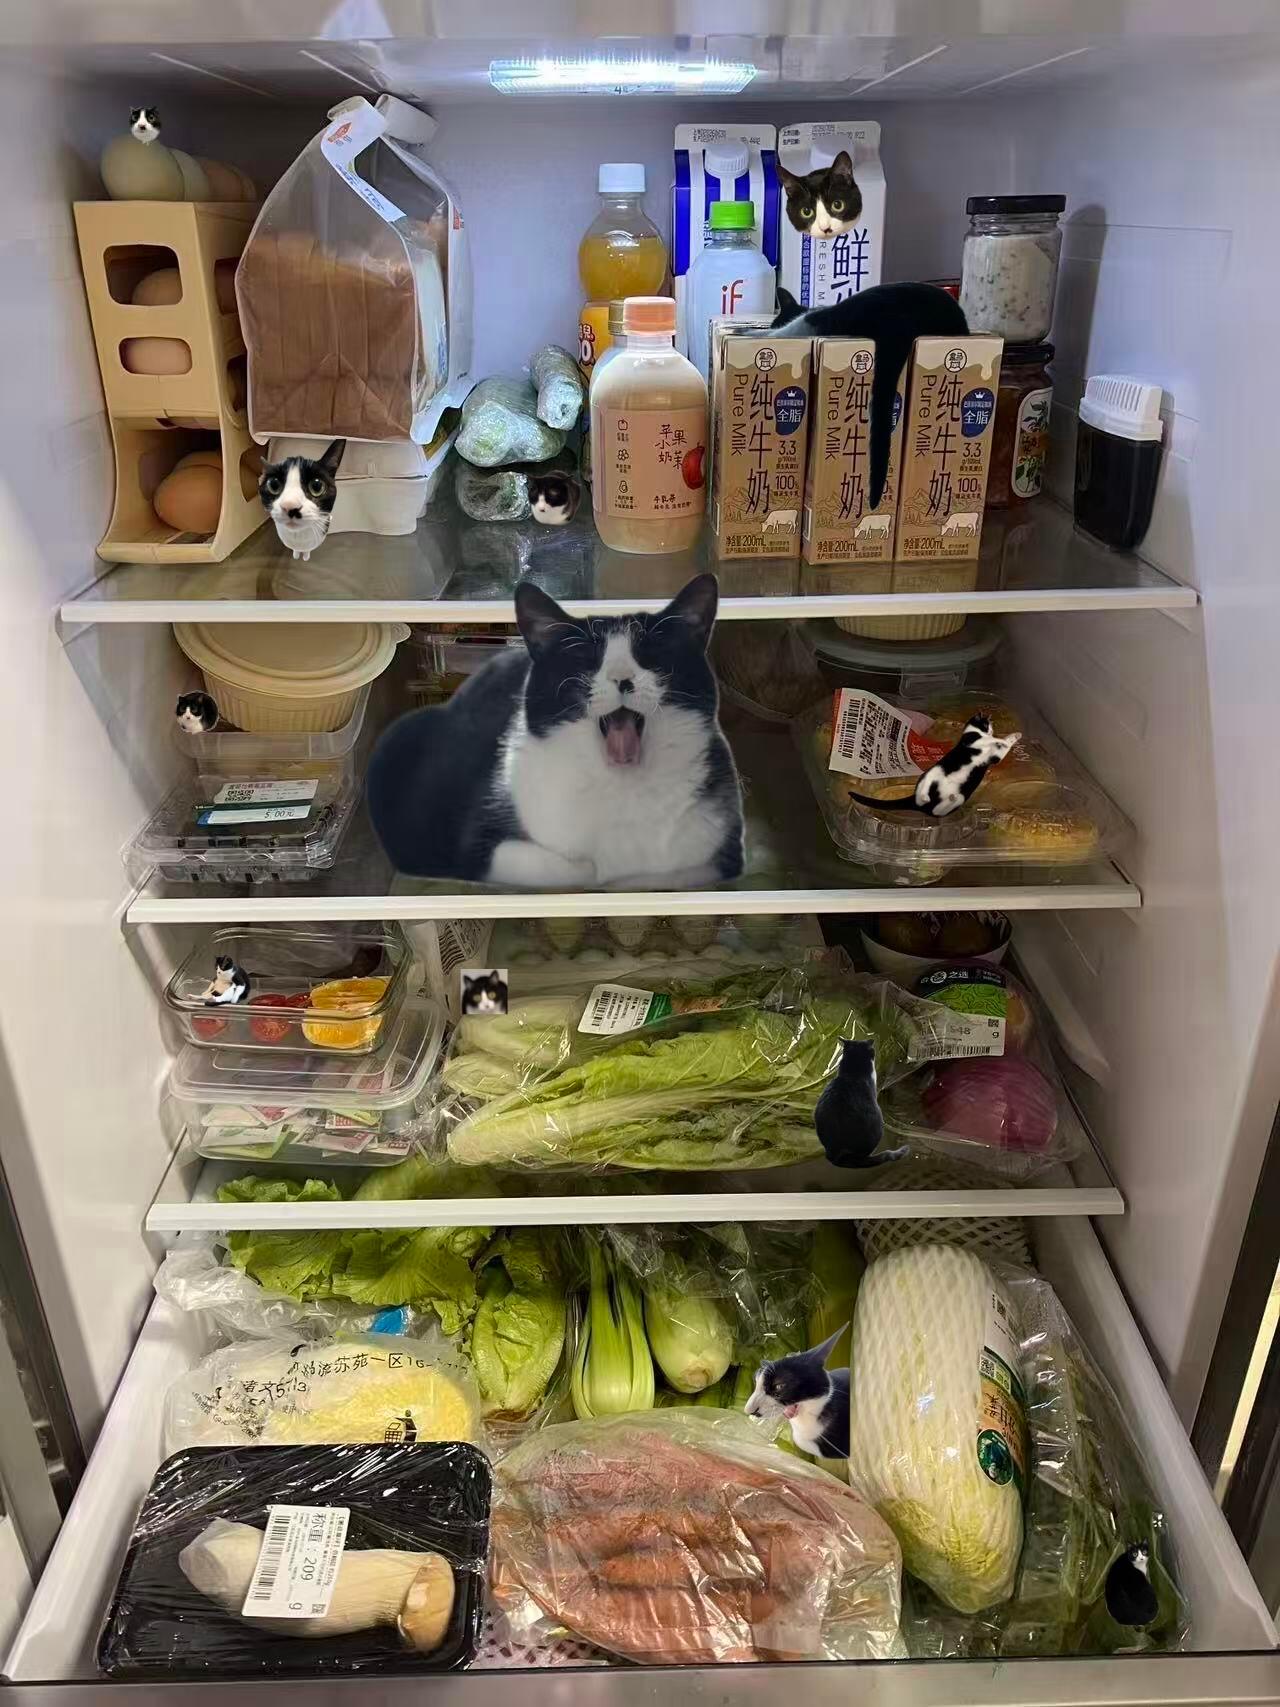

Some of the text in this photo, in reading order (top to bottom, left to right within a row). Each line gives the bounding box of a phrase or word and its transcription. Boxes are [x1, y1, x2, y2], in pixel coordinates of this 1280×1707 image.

[818, 241, 827, 281] RESH
[722, 279, 744, 315] if
[731, 374, 748, 456] Pure Milk
[746, 373, 775, 514] 纯牛奶
[777, 409, 801, 423] 全脂
[825, 376, 844, 461] Pure Milk
[915, 375, 937, 458] Pure Milk
[925, 374, 963, 517] 纯牛奶
[963, 410, 989, 425] 全脂
[778, 440, 797, 455] 3.3
[838, 376, 871, 519] 纯牛奶
[962, 442, 981, 457] 3.3
